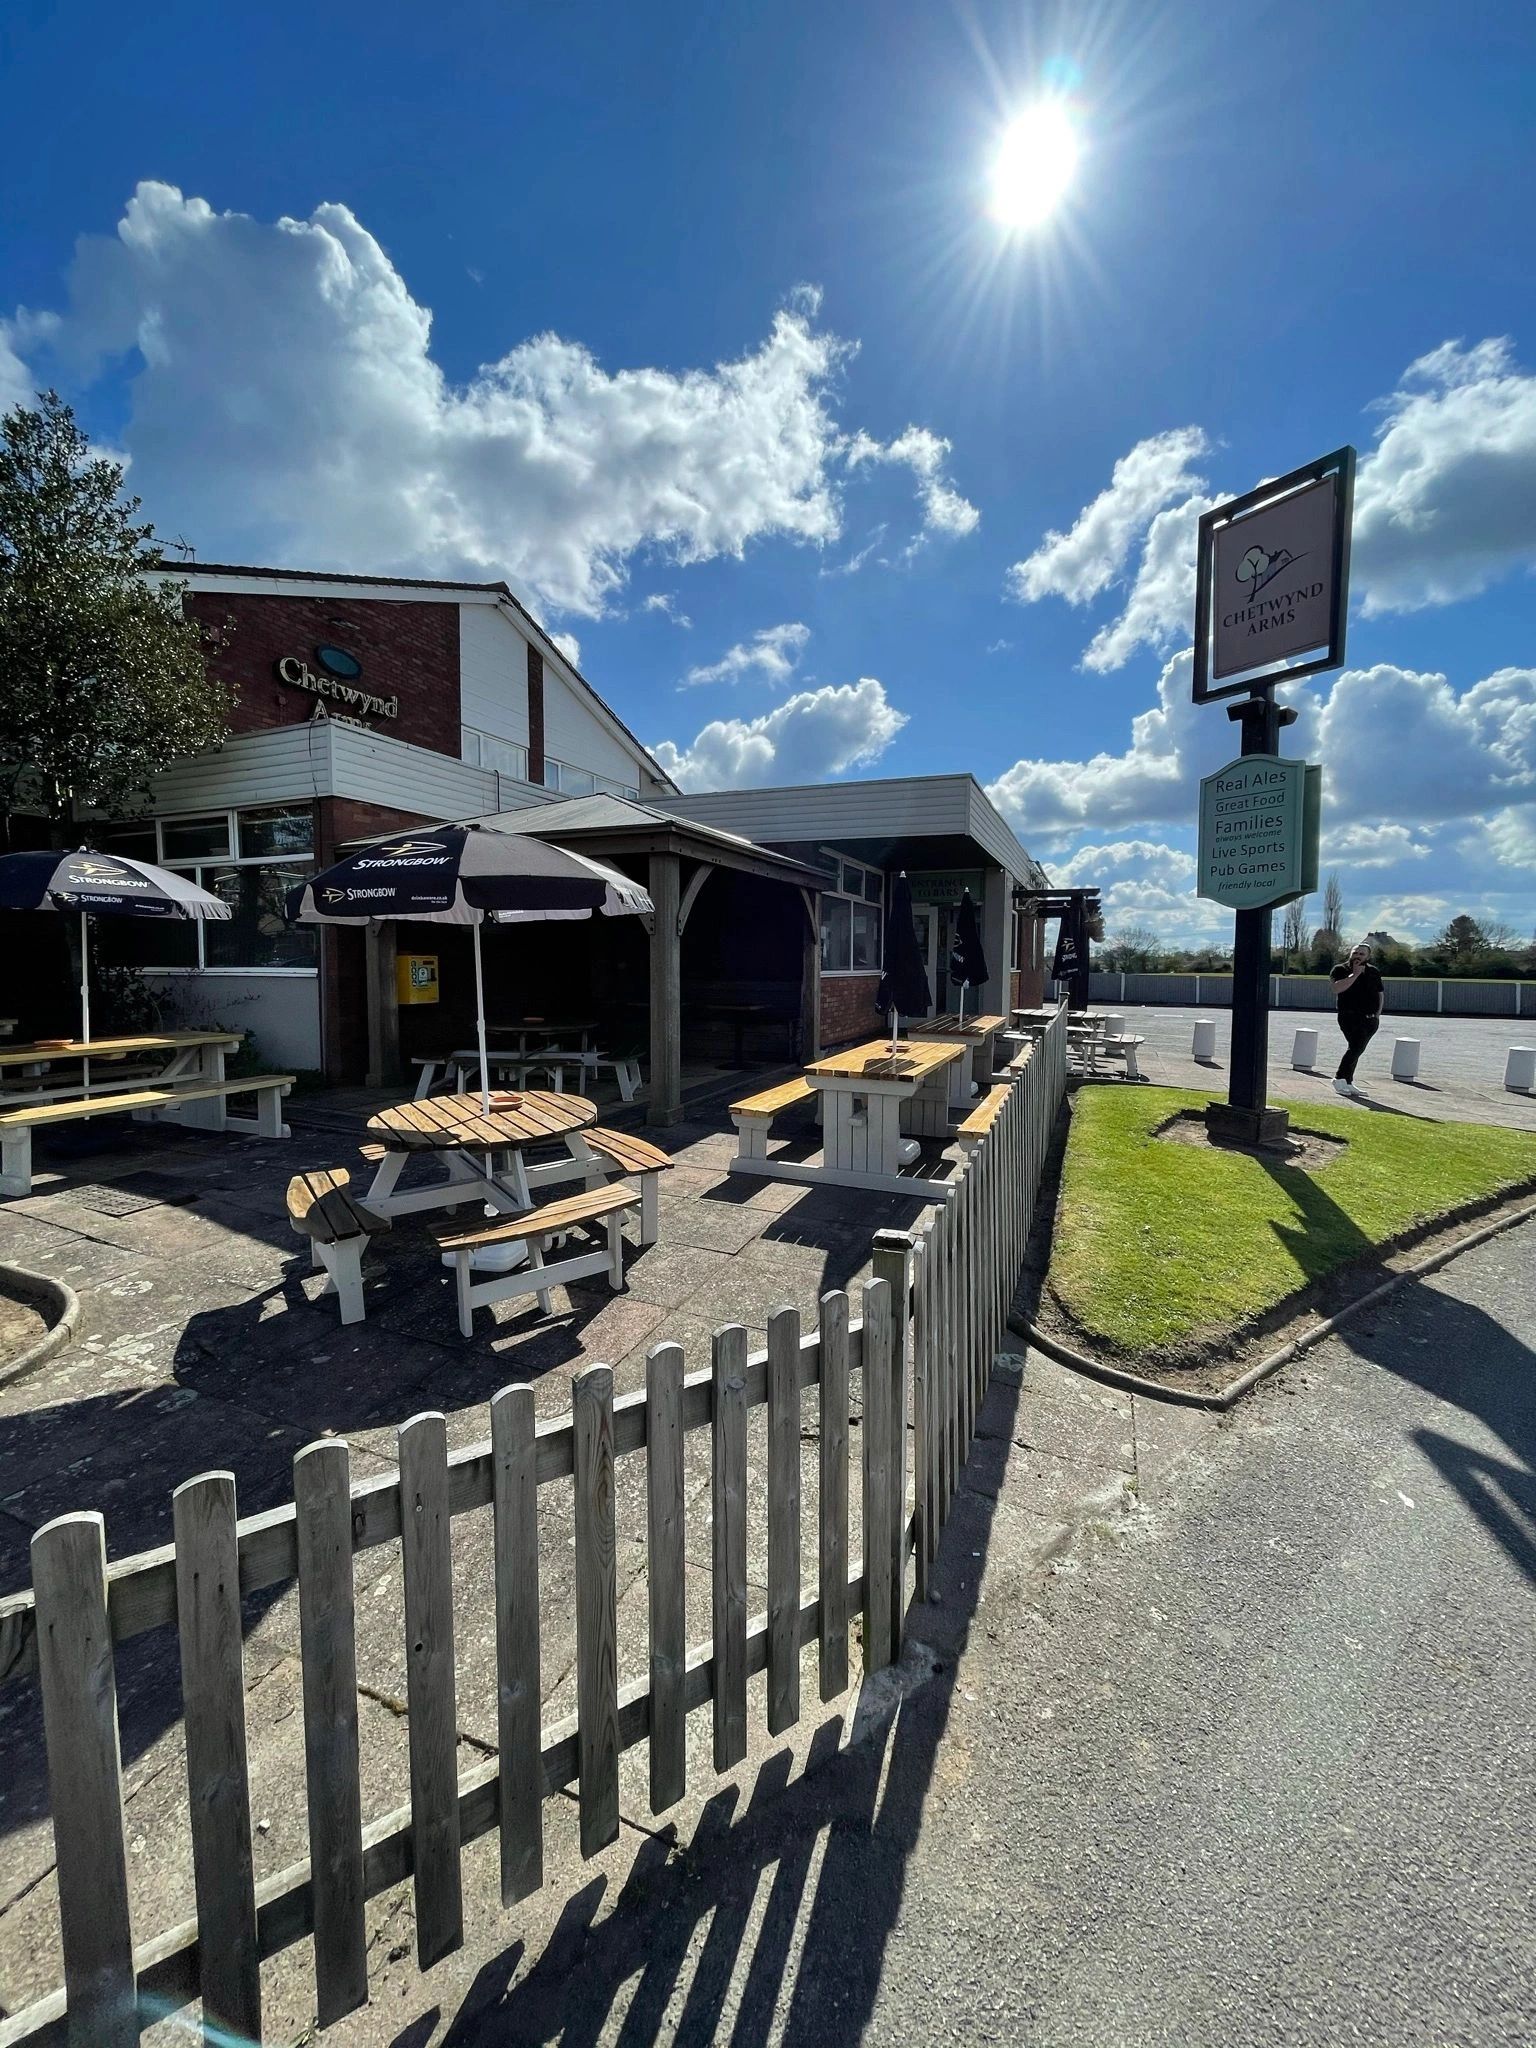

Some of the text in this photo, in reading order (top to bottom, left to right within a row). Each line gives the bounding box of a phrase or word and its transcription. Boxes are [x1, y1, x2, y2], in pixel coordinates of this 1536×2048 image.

[1222, 582, 1324, 628] CHETWYND
[1247, 608, 1296, 636] ARMS
[279, 657, 398, 718] Chetwynd
[1216, 771, 1287, 793] Real Ales
[1215, 792, 1285, 813] Great Food
[1215, 815, 1283, 834] Families
[1215, 829, 1282, 843] always welcome
[1212, 842, 1285, 859] Live Sports
[352, 856, 452, 870] STRONGBOW
[1210, 861, 1286, 877] Pub Games
[69, 875, 149, 888] STRONGBOW
[1218, 879, 1276, 893] friendly local
[80, 894, 123, 904] STRONGBOW
[346, 887, 396, 901] STRONGBOW
